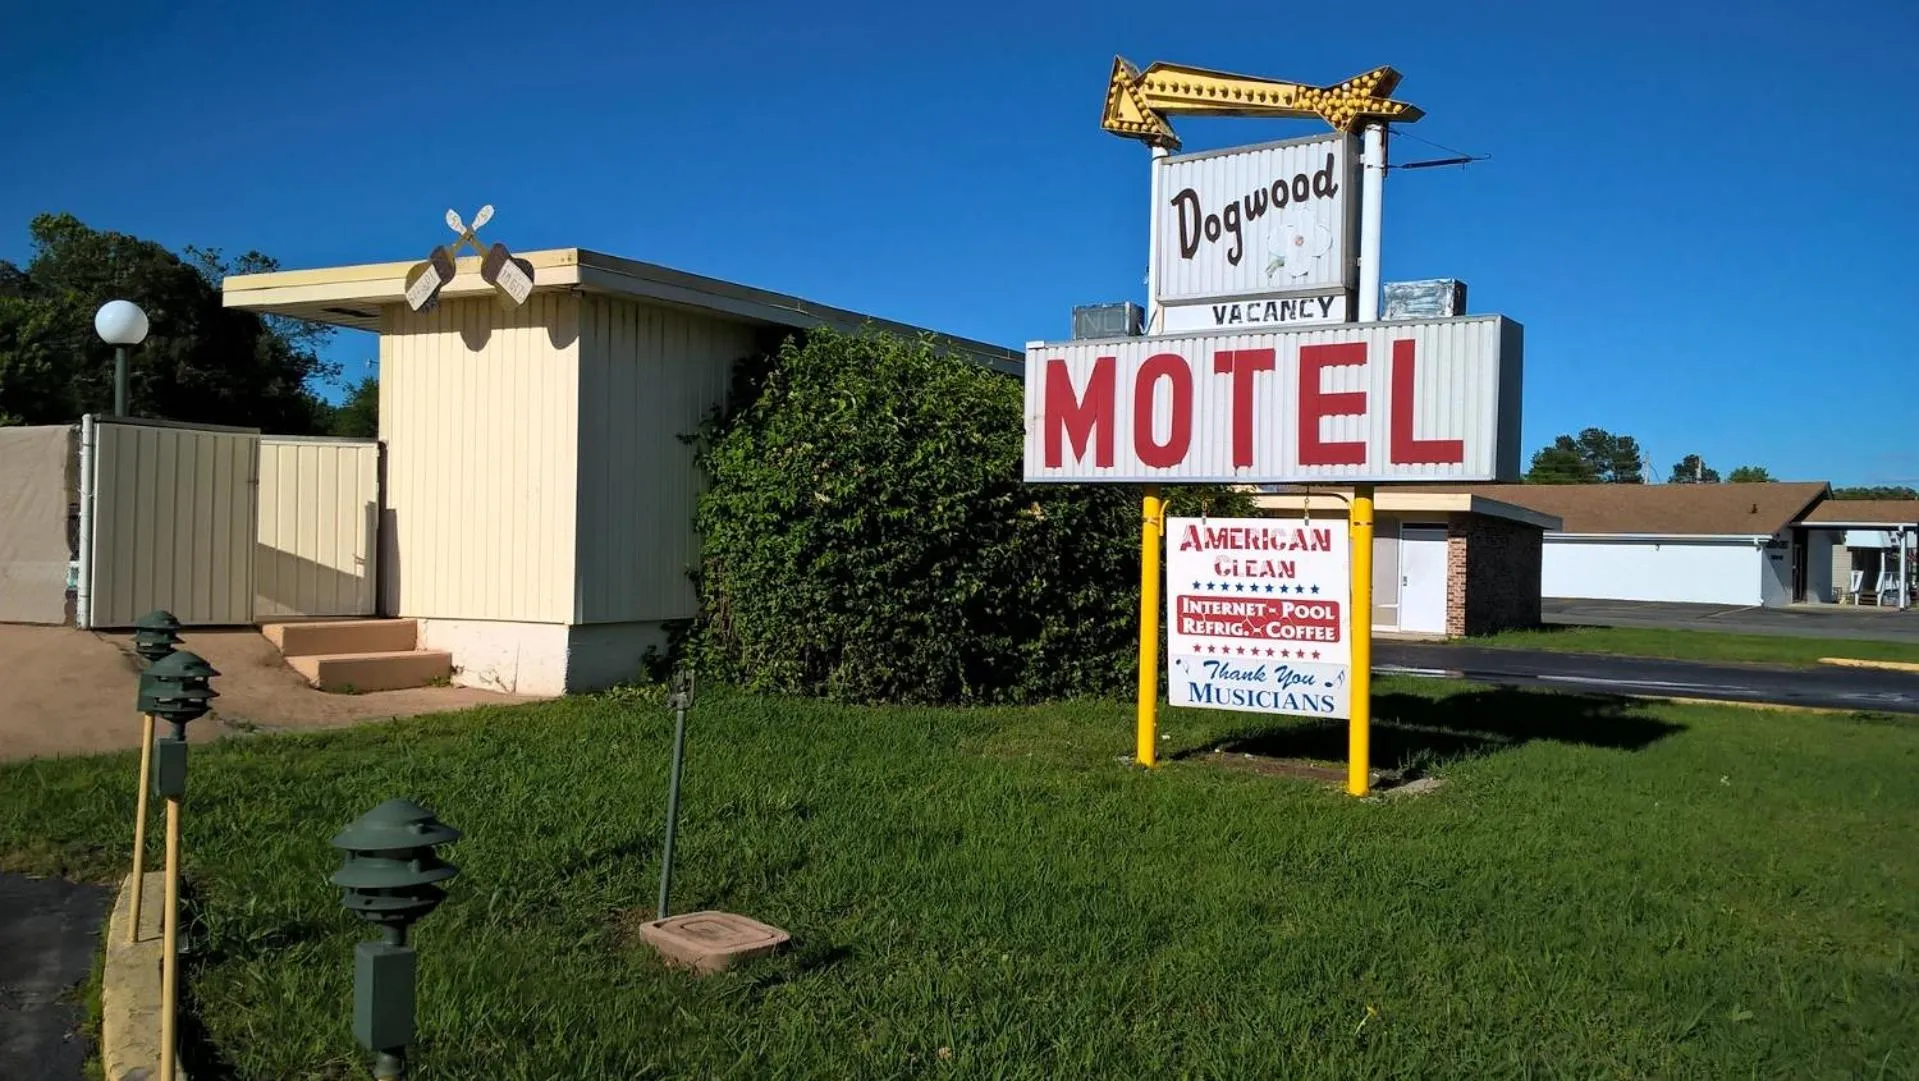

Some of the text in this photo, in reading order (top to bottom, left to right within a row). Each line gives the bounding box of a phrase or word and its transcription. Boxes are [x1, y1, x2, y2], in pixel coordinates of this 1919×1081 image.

[1171, 152, 1339, 266] Dogwood
[1212, 295, 1335, 325] VACANCY
[1044, 338, 1464, 469] MOTEL
[1180, 523, 1331, 552] AMERICAN
[1214, 554, 1296, 579] CLEAN
[1182, 597, 1267, 617] INTERNET
[1282, 601, 1336, 620] POOL
[1183, 618, 1249, 637] REFRIG.
[1266, 621, 1336, 641] COFFEE
[1203, 660, 1317, 690] Thank You
[1188, 682, 1336, 713] MUSICIANS
